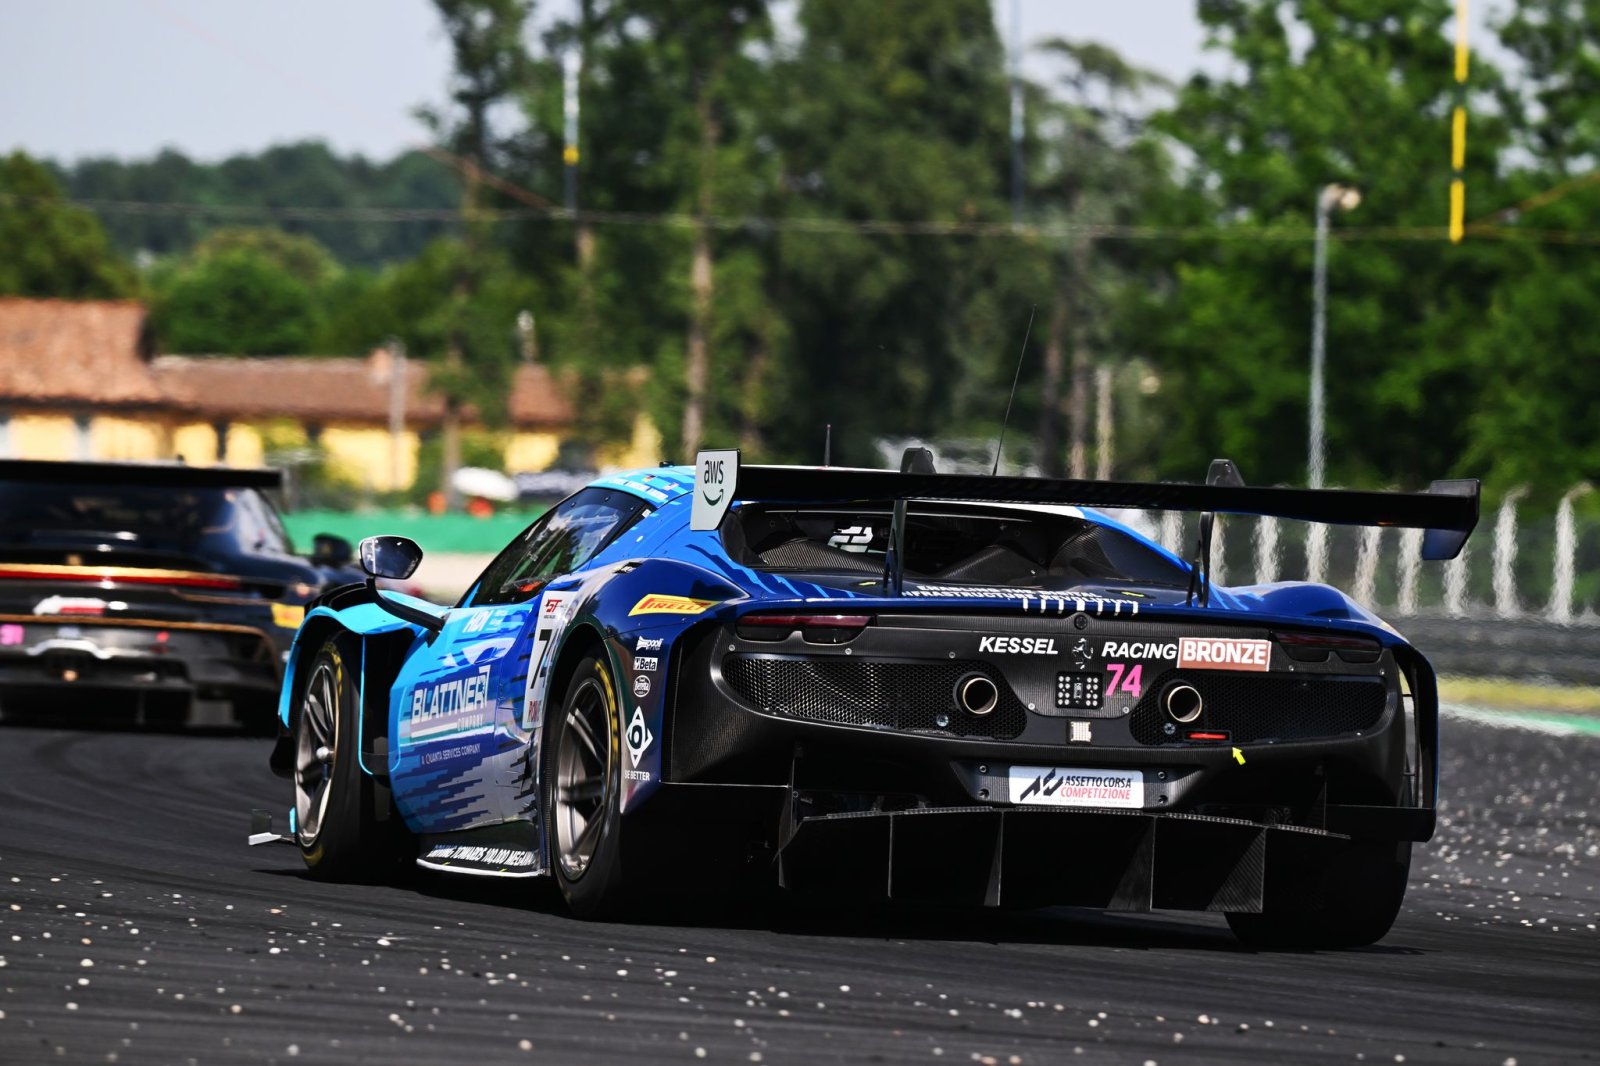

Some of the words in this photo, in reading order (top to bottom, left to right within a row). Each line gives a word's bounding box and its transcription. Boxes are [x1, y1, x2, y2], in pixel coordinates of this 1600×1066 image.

[703, 459, 724, 485] aws
[639, 597, 711, 612] PIRELLI
[978, 636, 1059, 655] KESSEL
[1101, 641, 1178, 660] RACING
[1182, 640, 1267, 665] BRONZE
[640, 657, 657, 670] Beta
[1104, 663, 1143, 697] 74
[411, 668, 490, 725] BLATTNER
[442, 747, 461, 760] SERVICES
[461, 743, 481, 756] COMPANY
[630, 770, 650, 781] BETTER
[1064, 775, 1103, 787] ASSETTO
[1103, 776, 1132, 789] CORSA
[1060, 786, 1131, 800] COMPETIZIONE
